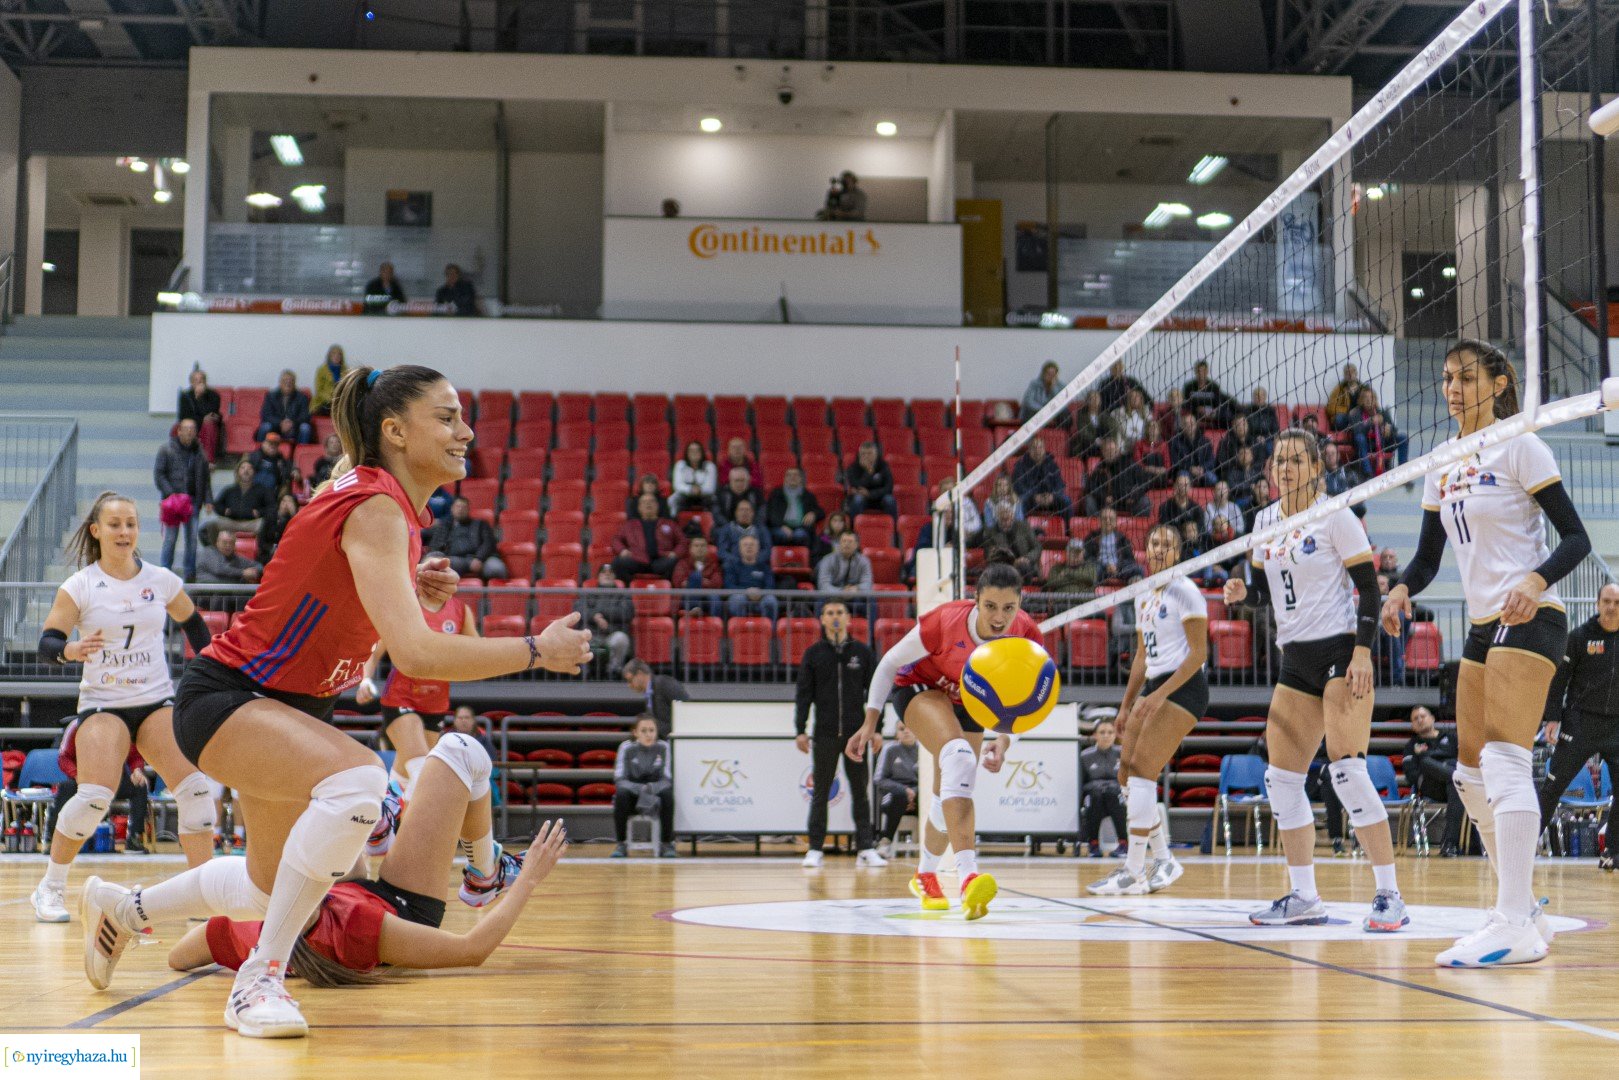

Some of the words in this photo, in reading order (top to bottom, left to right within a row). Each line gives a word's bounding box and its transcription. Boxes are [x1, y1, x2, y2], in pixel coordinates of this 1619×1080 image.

[688, 223, 855, 260] Continental
[1452, 500, 1472, 544] 11
[122, 624, 135, 650] 7
[963, 673, 987, 697] MIKASA
